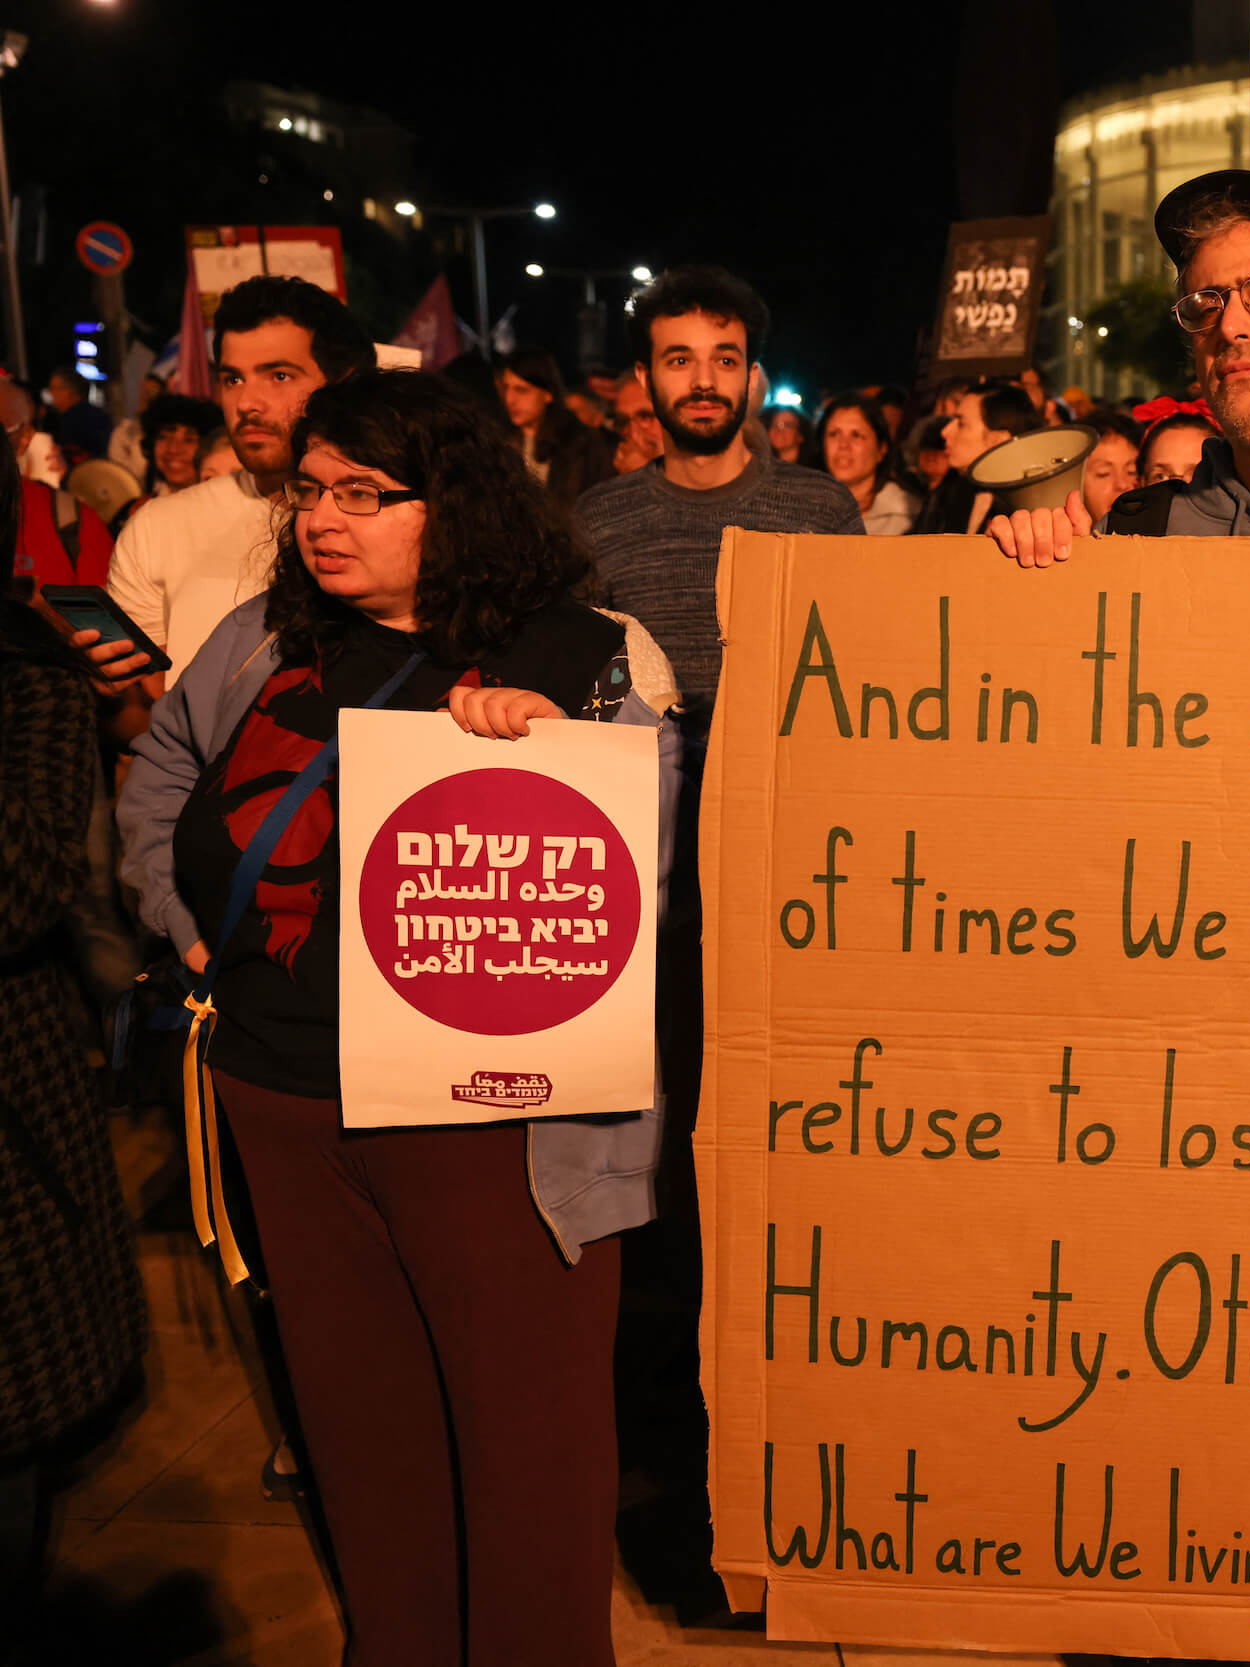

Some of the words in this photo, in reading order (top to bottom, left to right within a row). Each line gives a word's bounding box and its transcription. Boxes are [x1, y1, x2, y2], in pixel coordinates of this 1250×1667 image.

[779, 596, 949, 740] And
[977, 673, 1038, 743] in
[1082, 592, 1211, 748] the
[396, 823, 530, 869] שלום
[542, 835, 606, 880] רק
[396, 868, 509, 909] السلام
[519, 881, 605, 912] وحده
[779, 827, 853, 951] of
[892, 831, 1077, 957] times
[1122, 838, 1228, 961] We
[394, 914, 522, 947] ביטחון
[530, 917, 609, 944] יביא
[393, 942, 475, 979] الأمن
[483, 945, 609, 982] سيجلب
[454, 1086, 491, 1097] ביחד
[495, 1087, 548, 1097] עומדים
[510, 1074, 548, 1088] نقف
[768, 1038, 1003, 1160] refuse
[1049, 1047, 1116, 1164] to
[765, 1223, 1130, 1432] Humanity.
[764, 1441, 929, 1574] What
[935, 1538, 1022, 1576] are
[1054, 1463, 1142, 1580] We
